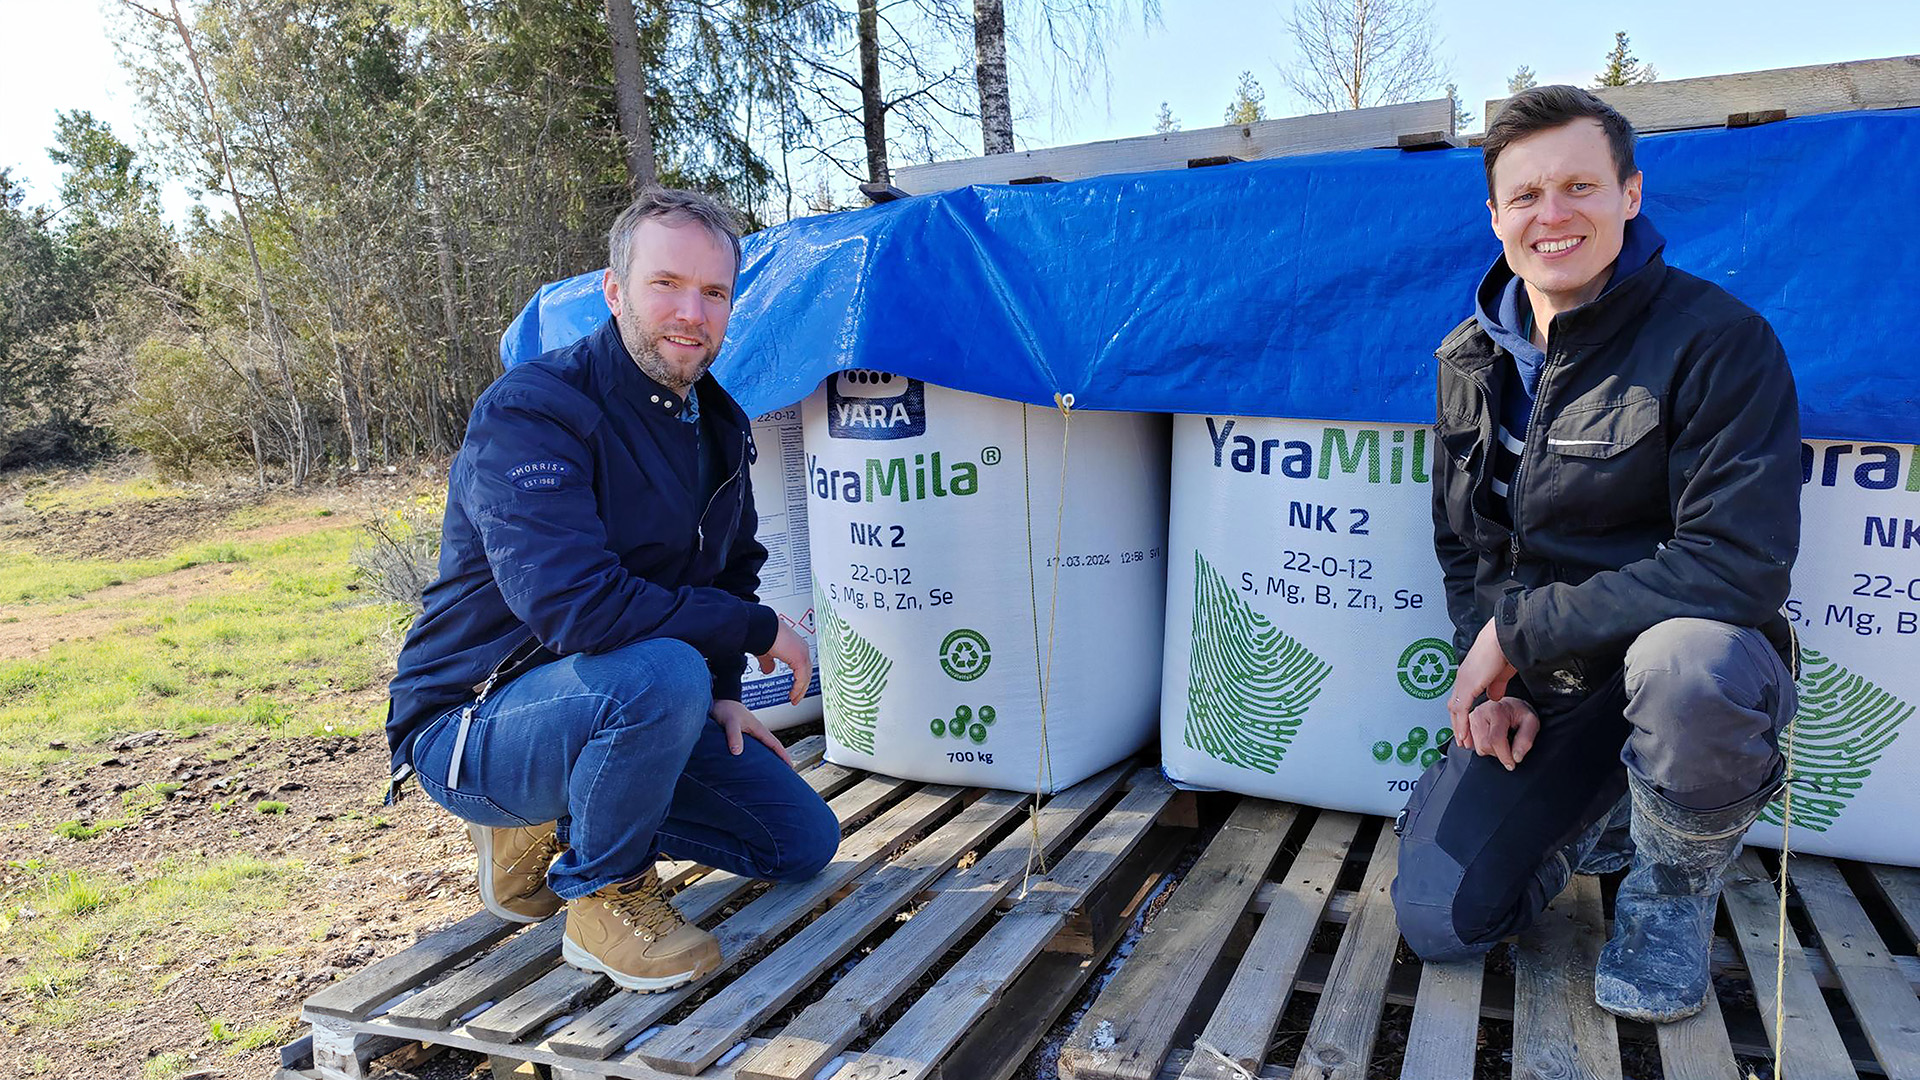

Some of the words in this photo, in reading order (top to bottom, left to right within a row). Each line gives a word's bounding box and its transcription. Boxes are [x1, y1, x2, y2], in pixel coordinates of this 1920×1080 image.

[757, 410, 797, 423] 22-0-12
[836, 402, 911, 428] YARA
[1205, 416, 1430, 485] YaraMil
[515, 463, 558, 476] MORRIS
[524, 479, 538, 488] EST
[1288, 501, 1338, 534] NK
[1349, 508, 1370, 536] 2
[850, 522, 883, 548] NK
[889, 525, 906, 548] 2
[850, 563, 912, 585] 22-0-12
[1283, 550, 1373, 580] 22-0-12
[829, 583, 841, 604] S,
[843, 586, 869, 610] Mg,
[874, 591, 890, 612] B,
[895, 593, 923, 611] Zn,
[929, 588, 954, 607] Se
[1241, 572, 1259, 596] S,
[1266, 576, 1306, 605] Mg,
[1315, 584, 1338, 609] B,
[1347, 588, 1384, 613] Zn,
[1393, 589, 1424, 610] Se
[1785, 600, 1811, 627] S,
[1824, 604, 1882, 636] Mg,
[946, 751, 975, 763] 700
[977, 751, 994, 765] kg
